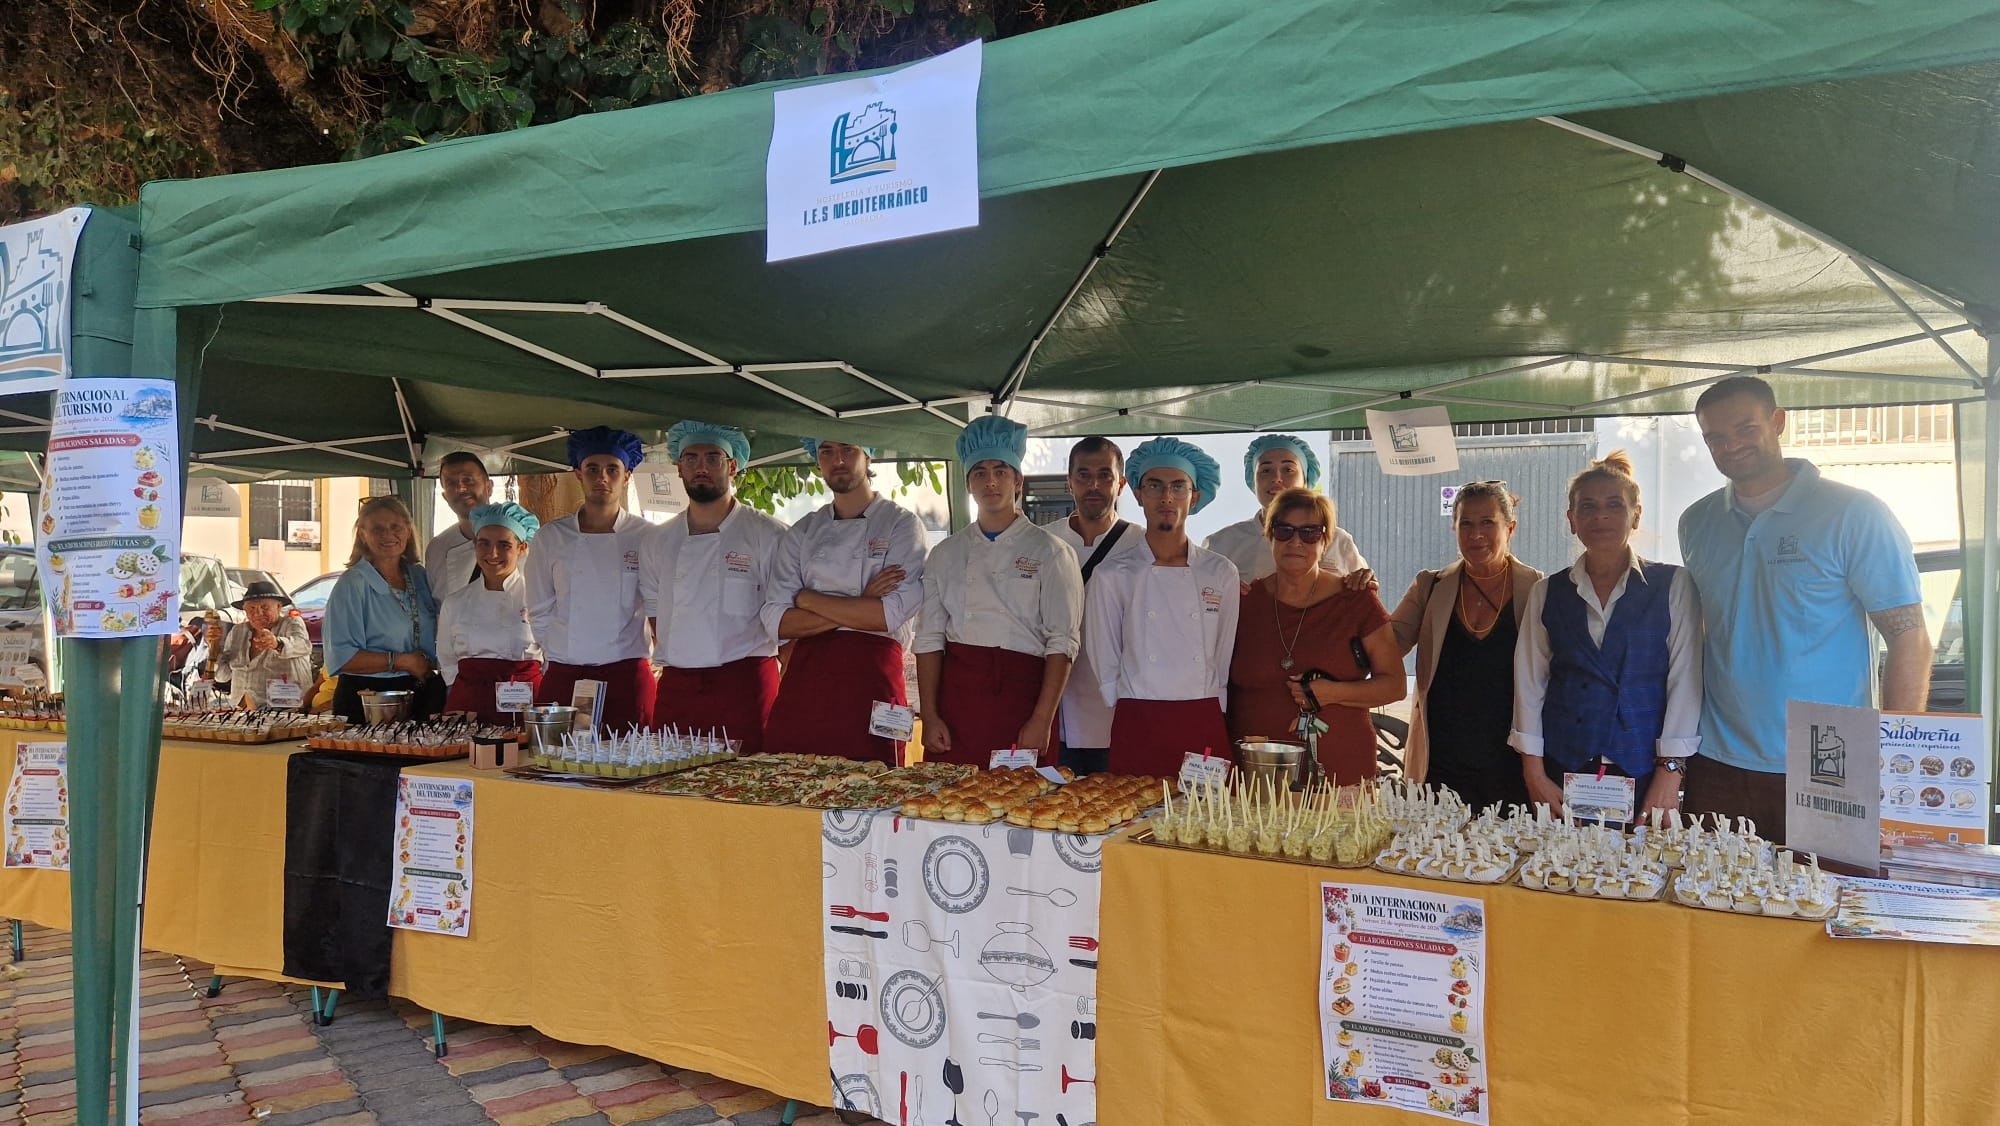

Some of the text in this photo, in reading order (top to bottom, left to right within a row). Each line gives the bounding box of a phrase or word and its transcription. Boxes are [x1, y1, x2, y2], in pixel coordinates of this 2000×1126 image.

[803, 186, 928, 226] I.E.S MEDITERRÁNEO
[62, 402, 113, 416] TURISMO
[89, 437, 126, 446] SALADAS
[1880, 721, 1961, 742] Salobreña
[1880, 742, 1916, 750] periencias
[427, 790, 451, 799] TURISMO
[1813, 796, 1866, 819] MEDITERRÁNEO
[1352, 892, 1448, 913] DÍA INTERNACIONAL
[1366, 906, 1437, 923] DEL TURISMO
[1359, 935, 1446, 953] ELABORACIONES SALADAS
[1351, 1023, 1399, 1036] ELABORACIONES
[1428, 1035, 1453, 1045] FRUTAS
